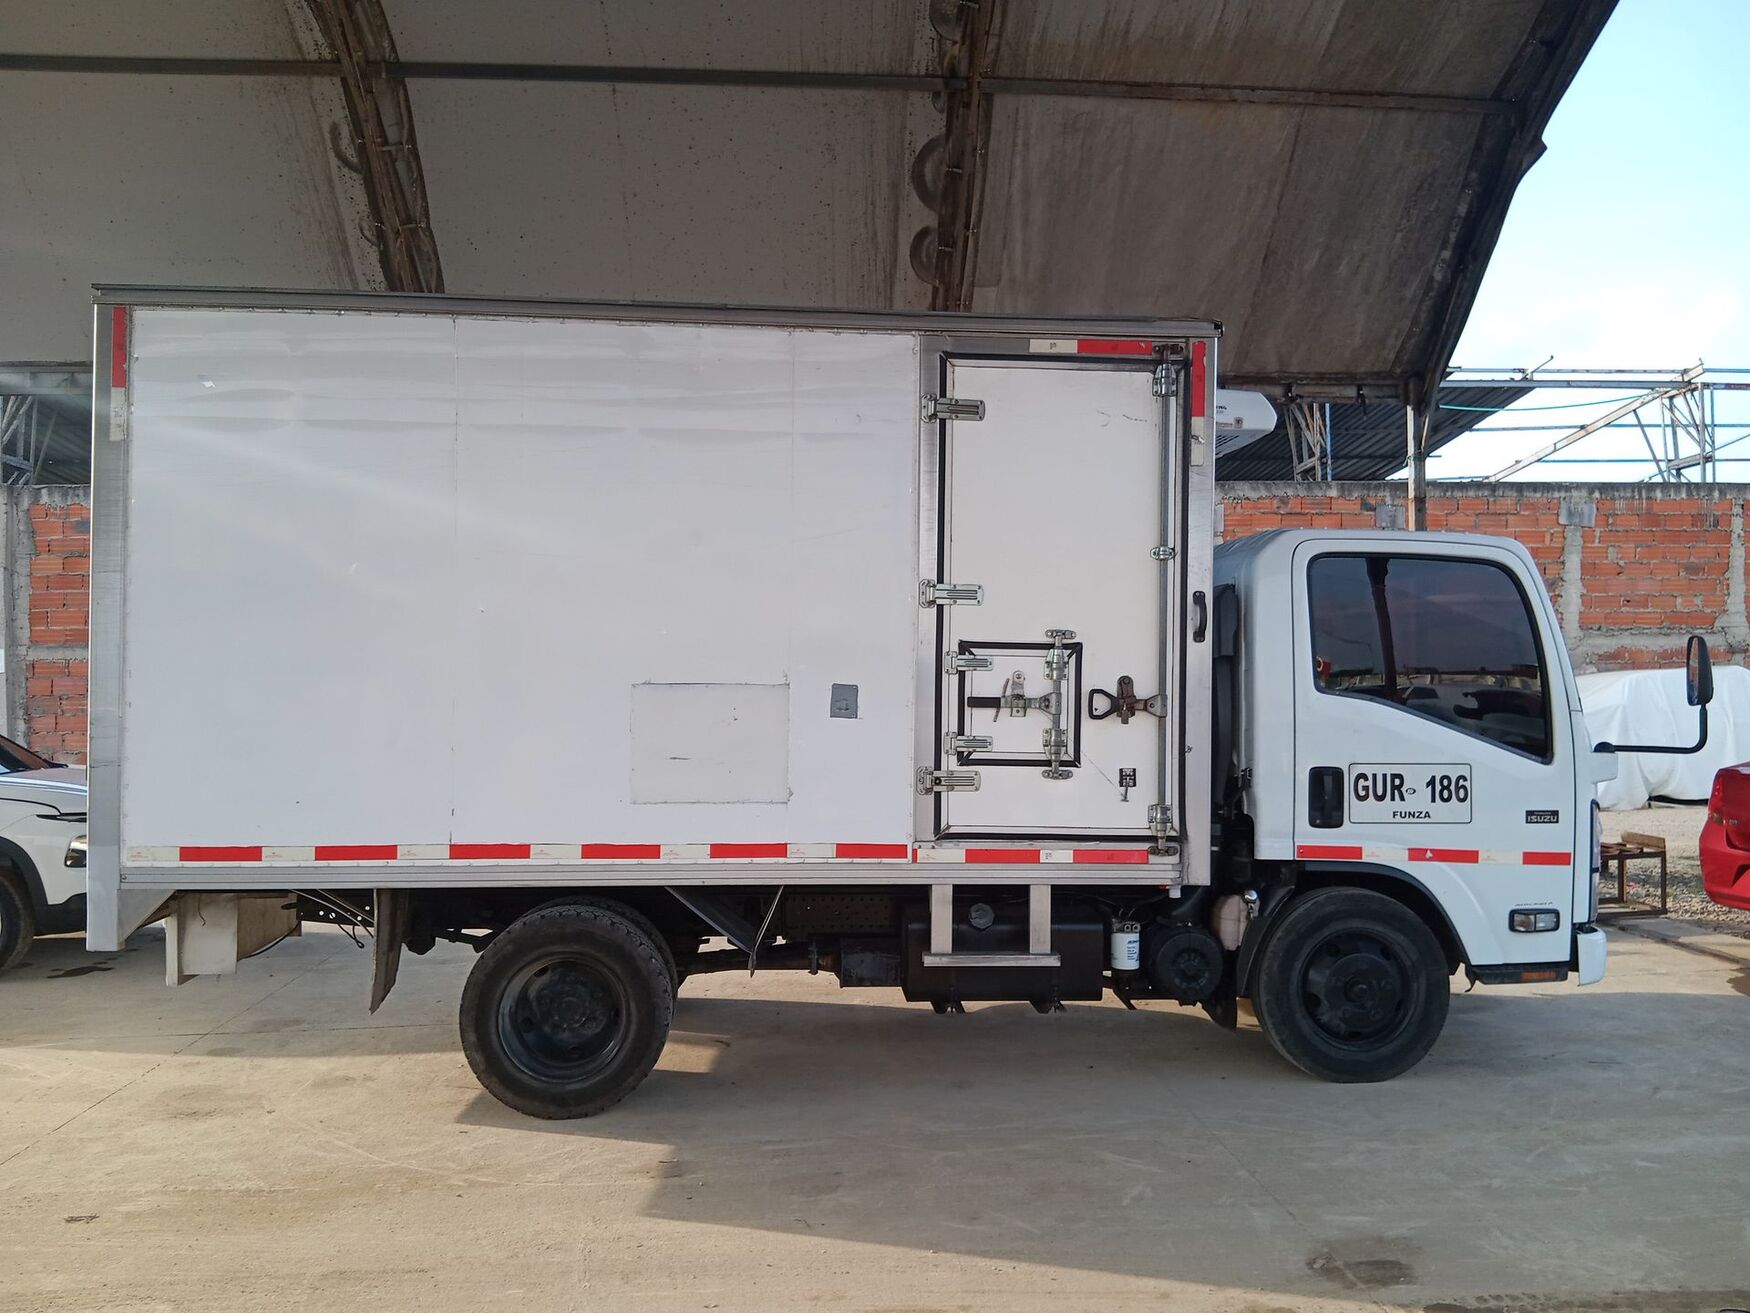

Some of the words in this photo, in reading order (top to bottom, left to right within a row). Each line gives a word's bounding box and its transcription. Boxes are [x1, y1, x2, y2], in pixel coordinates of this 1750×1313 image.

[1353, 772, 1406, 802] GUR
[1425, 775, 1469, 803] 186
[1392, 811, 1431, 819] FUNZA
